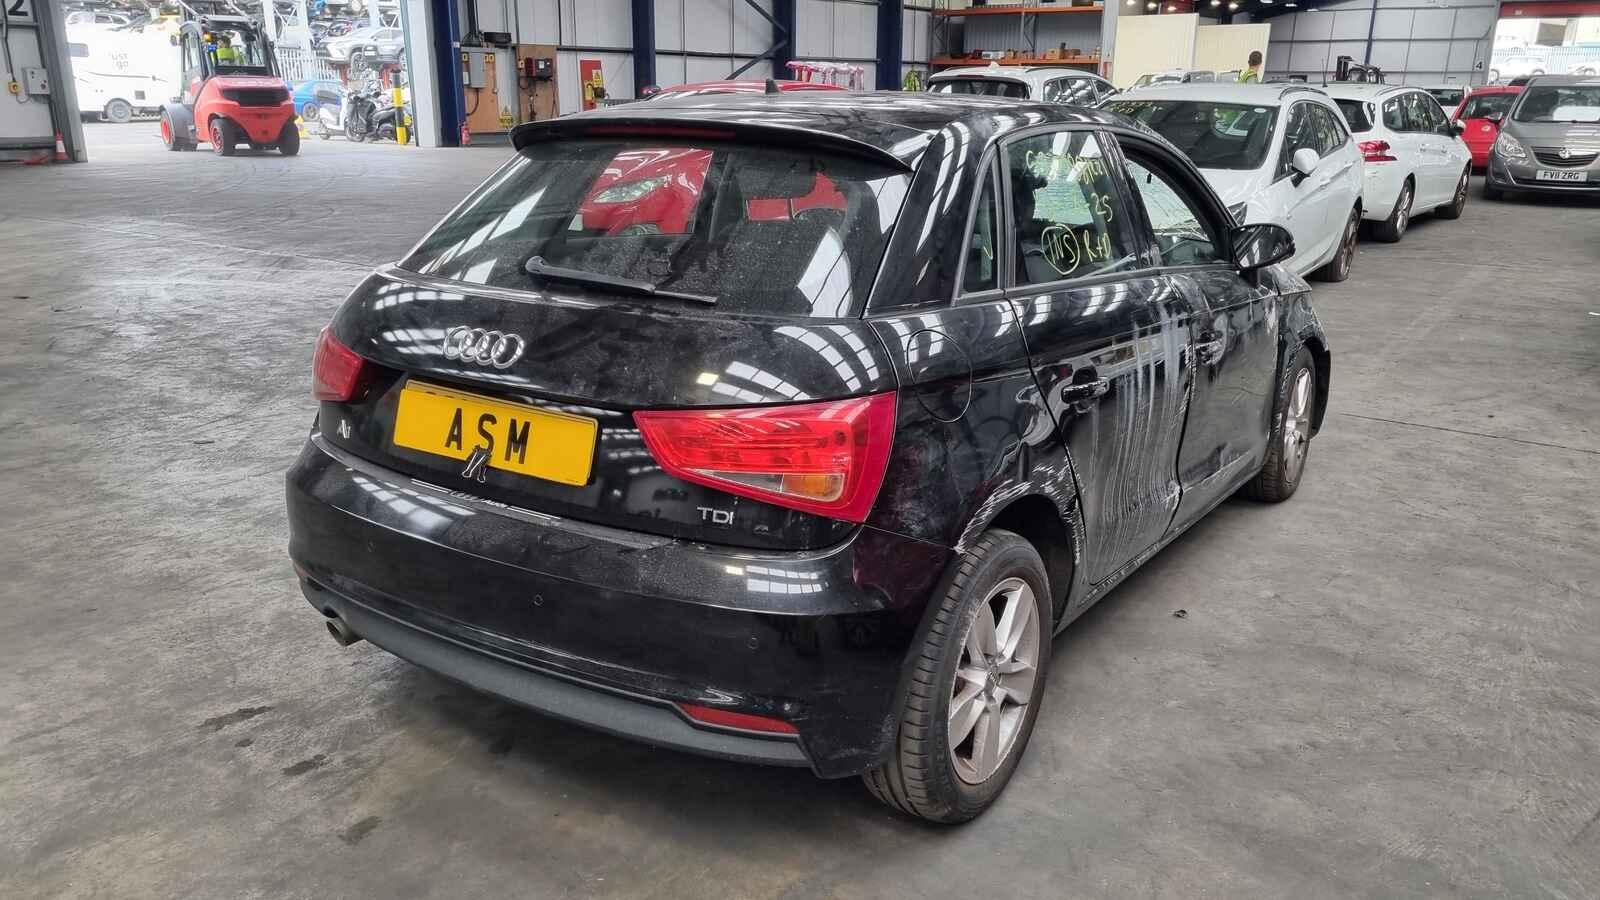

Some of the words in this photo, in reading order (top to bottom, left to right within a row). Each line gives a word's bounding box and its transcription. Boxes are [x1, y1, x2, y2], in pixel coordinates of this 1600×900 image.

[1475, 60, 1483, 69] 4
[1561, 172, 1580, 180] ZRG
[697, 506, 734, 525] TDI
